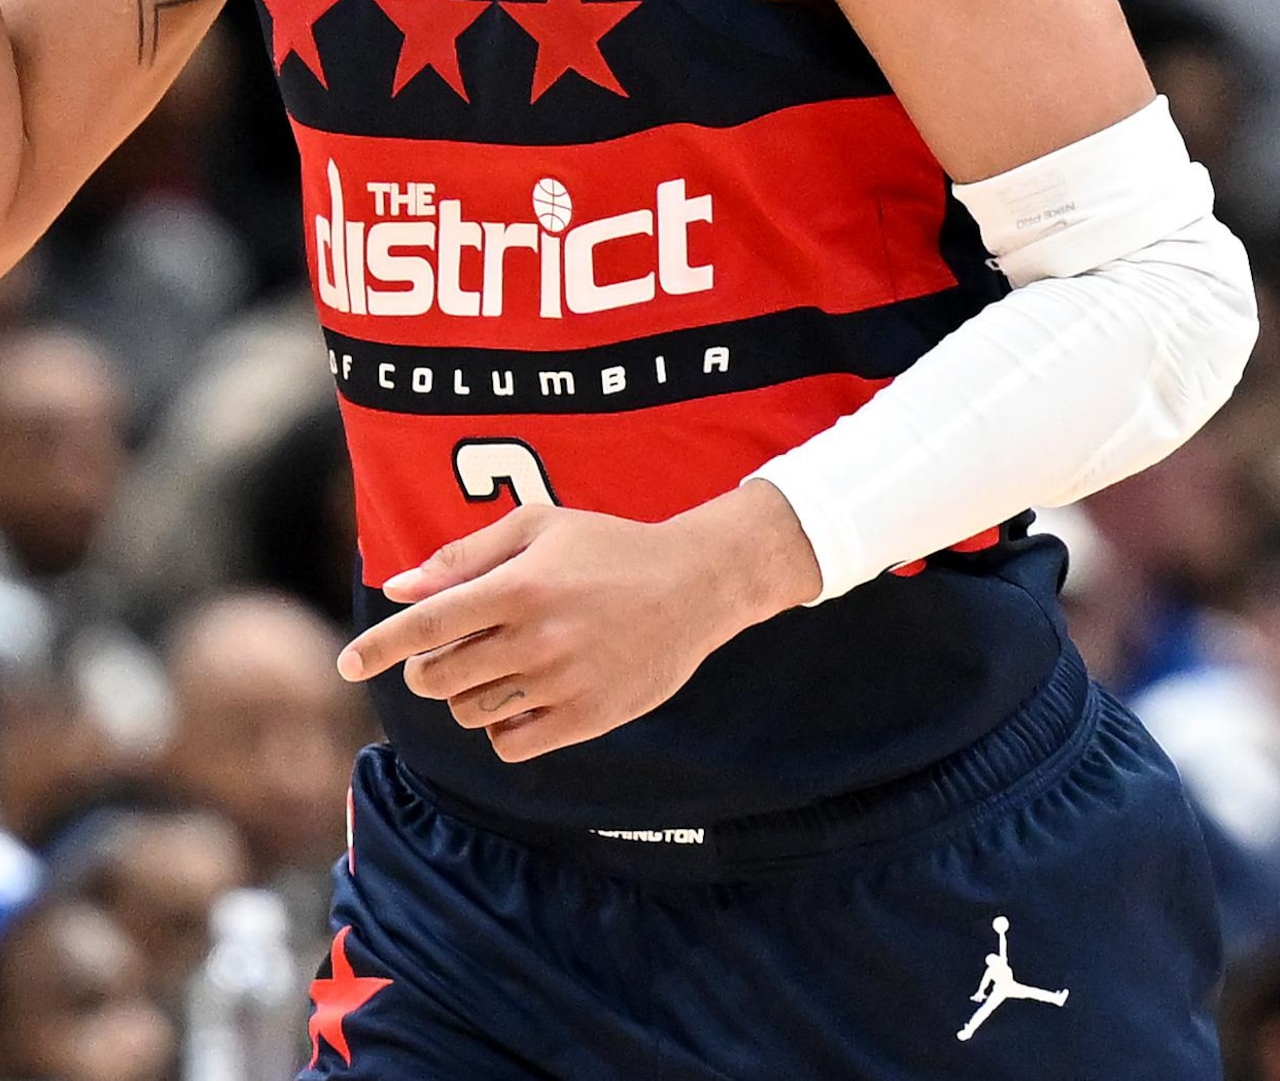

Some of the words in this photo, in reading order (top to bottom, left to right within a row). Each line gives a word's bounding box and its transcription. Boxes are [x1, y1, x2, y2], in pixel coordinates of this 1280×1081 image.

[366, 182, 436, 216] THE
[315, 157, 714, 318] district
[378, 346, 730, 396] COLUMBIA
